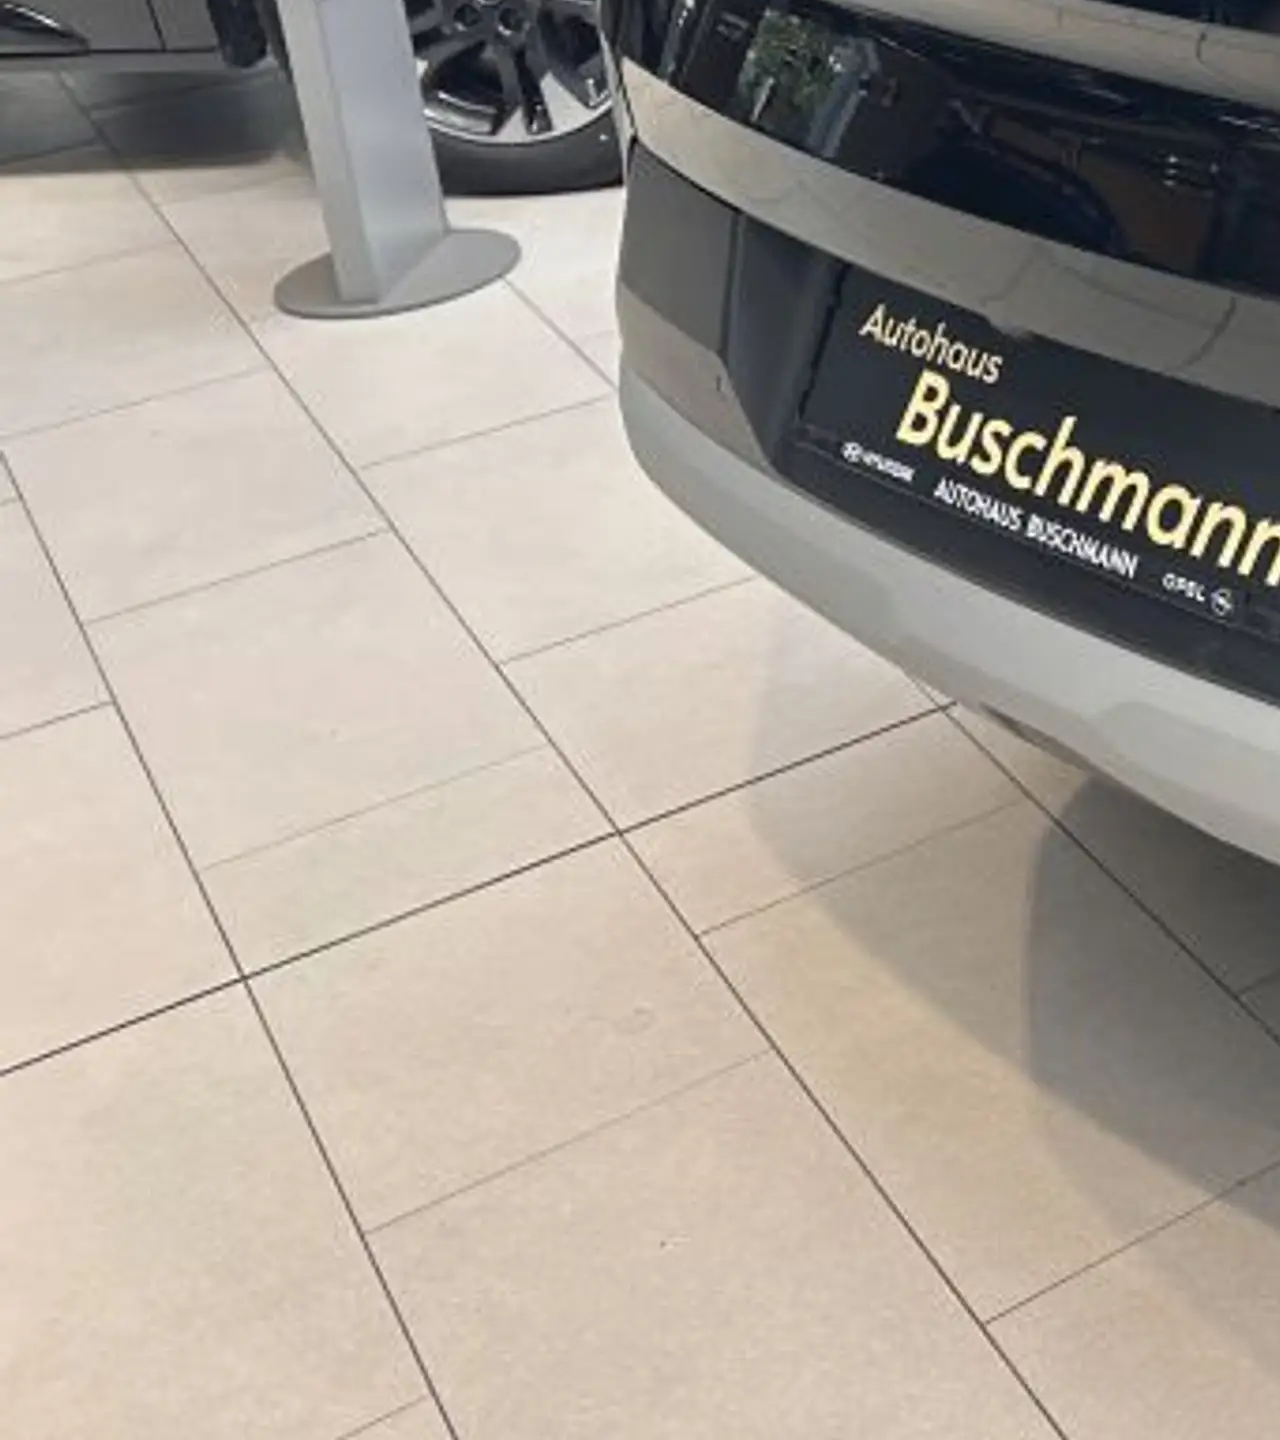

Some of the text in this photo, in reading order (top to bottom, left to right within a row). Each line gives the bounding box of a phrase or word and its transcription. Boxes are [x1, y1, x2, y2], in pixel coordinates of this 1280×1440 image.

[859, 303, 1003, 385] Autohaus
[933, 477, 1139, 580] AUTOHAUS BUSCHMANN
